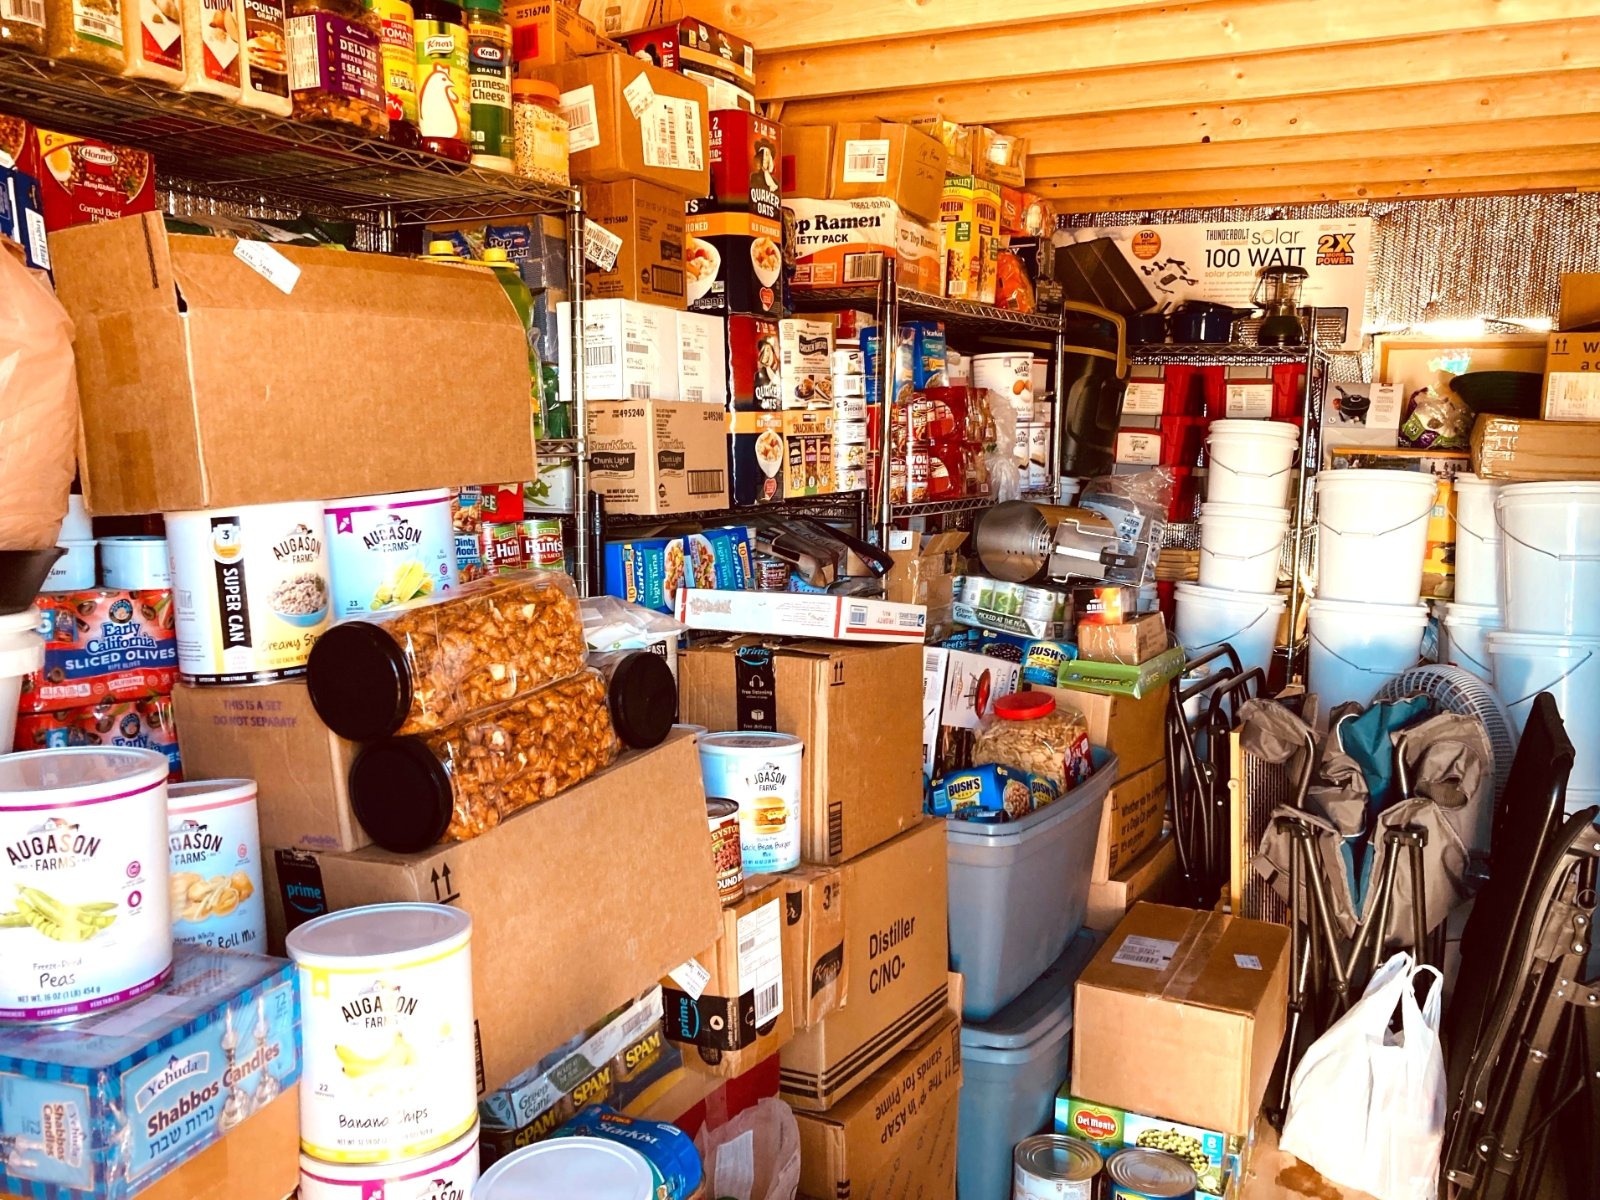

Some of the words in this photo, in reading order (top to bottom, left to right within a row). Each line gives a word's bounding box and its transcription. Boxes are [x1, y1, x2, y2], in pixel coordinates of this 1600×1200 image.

[245, 1, 283, 19] POULTRY
[256, 12, 277, 22] GRAVY
[340, 38, 377, 63] DELUXE
[427, 38, 453, 49] Knorr
[480, 48, 498, 57] Kraft
[341, 53, 363, 65] MIXED
[363, 59, 377, 71] NUTS
[477, 67, 501, 75] GRATED
[347, 63, 361, 76] SEA
[362, 69, 377, 82] SALT
[472, 88, 505, 102] Cheese
[713, 117, 718, 129] 2
[45, 135, 52, 146] 6
[84, 150, 113, 161] Hormel
[751, 188, 780, 209] QUAKER
[79, 203, 104, 214] Corned
[105, 208, 121, 218] Beef
[757, 202, 774, 217] OATS
[976, 203, 997, 222] PROTEIN
[815, 213, 881, 230] Ramen
[490, 237, 511, 249] Top
[822, 234, 849, 243] PACK
[1206, 229, 1250, 241] THUNDERBOLT
[1252, 227, 1301, 245] solar
[1317, 233, 1355, 253] 2X
[1205, 248, 1241, 268] 100
[1248, 246, 1307, 267] WATT
[1316, 256, 1353, 265] POWER
[1205, 270, 1225, 278] solar
[1227, 269, 1252, 280] panel
[619, 408, 645, 418] 495240
[793, 423, 814, 434] SNACKING
[815, 422, 826, 433] NUTS
[590, 439, 637, 451] StarKist
[613, 456, 630, 466] Light
[222, 530, 229, 540] 3
[362, 528, 423, 550] AUGASON
[272, 535, 322, 561] AUGASON
[383, 542, 410, 554] FARMS
[739, 545, 746, 556] 10
[292, 554, 314, 565] FARMS
[731, 543, 744, 588] StarKist
[636, 549, 646, 602] StarKist
[721, 562, 729, 587] Tuna
[222, 567, 241, 612] SUPER
[627, 588, 636, 600] 10
[349, 600, 358, 608] 23
[954, 605, 973, 615] Green
[978, 612, 997, 622] PICKED
[103, 621, 141, 638] Early
[228, 616, 245, 642] CAN
[86, 633, 156, 653] California
[739, 646, 770, 658] prime
[942, 641, 959, 649] Beef
[65, 652, 121, 670] SLICED
[125, 648, 176, 661] OLIVES
[1029, 646, 1067, 662] BUSH'S
[224, 700, 243, 710] THIS
[246, 701, 254, 710] IS
[257, 701, 264, 710] A
[214, 716, 227, 725] DO
[228, 716, 248, 726] NOT
[250, 716, 297, 727] SEPARATE
[948, 777, 980, 797] BUSH'S
[6, 835, 101, 867] AUGASON
[774, 840, 792, 849] Burger
[35, 856, 76, 871] FARMS
[175, 850, 207, 866] FARMS
[287, 882, 322, 900] prime
[823, 884, 831, 911] 3
[218, 932, 238, 948] Roll
[241, 929, 257, 944] Mix
[869, 916, 916, 960] Distiller
[39, 972, 76, 989] Peas
[869, 955, 906, 994] C/NO.
[18, 995, 30, 1003] NET
[45, 993, 51, 1001] 16
[52, 992, 62, 1001] OZ
[83, 986, 95, 995] 454
[275, 995, 287, 1008] 72
[678, 997, 692, 1038] prime
[626, 1031, 661, 1068] SPAM
[917, 1047, 943, 1081] stands
[147, 1058, 201, 1095] Yehuda
[902, 1073, 916, 1095] for
[928, 1071, 943, 1092] The
[147, 1084, 220, 1138] Shabbos
[222, 1041, 280, 1087] Candles
[319, 1083, 329, 1092] 22
[573, 1067, 610, 1106] SPAM
[518, 1084, 549, 1110] Green
[875, 1087, 901, 1121] Prime
[524, 1094, 551, 1119] Giant
[907, 1098, 917, 1116] in
[43, 1104, 55, 1156] Candles
[184, 1105, 216, 1137] נרות
[338, 1113, 389, 1129] Banana
[515, 1109, 556, 1148] SPAM
[881, 1107, 906, 1145] ASAP
[1077, 1114, 1091, 1126] Del
[1091, 1117, 1116, 1132] Monte
[54, 1104, 66, 1160] Shabbos
[596, 1122, 660, 1145] StarKist
[149, 1127, 181, 1159] שבת
[1207, 1137, 1216, 1148] 8
